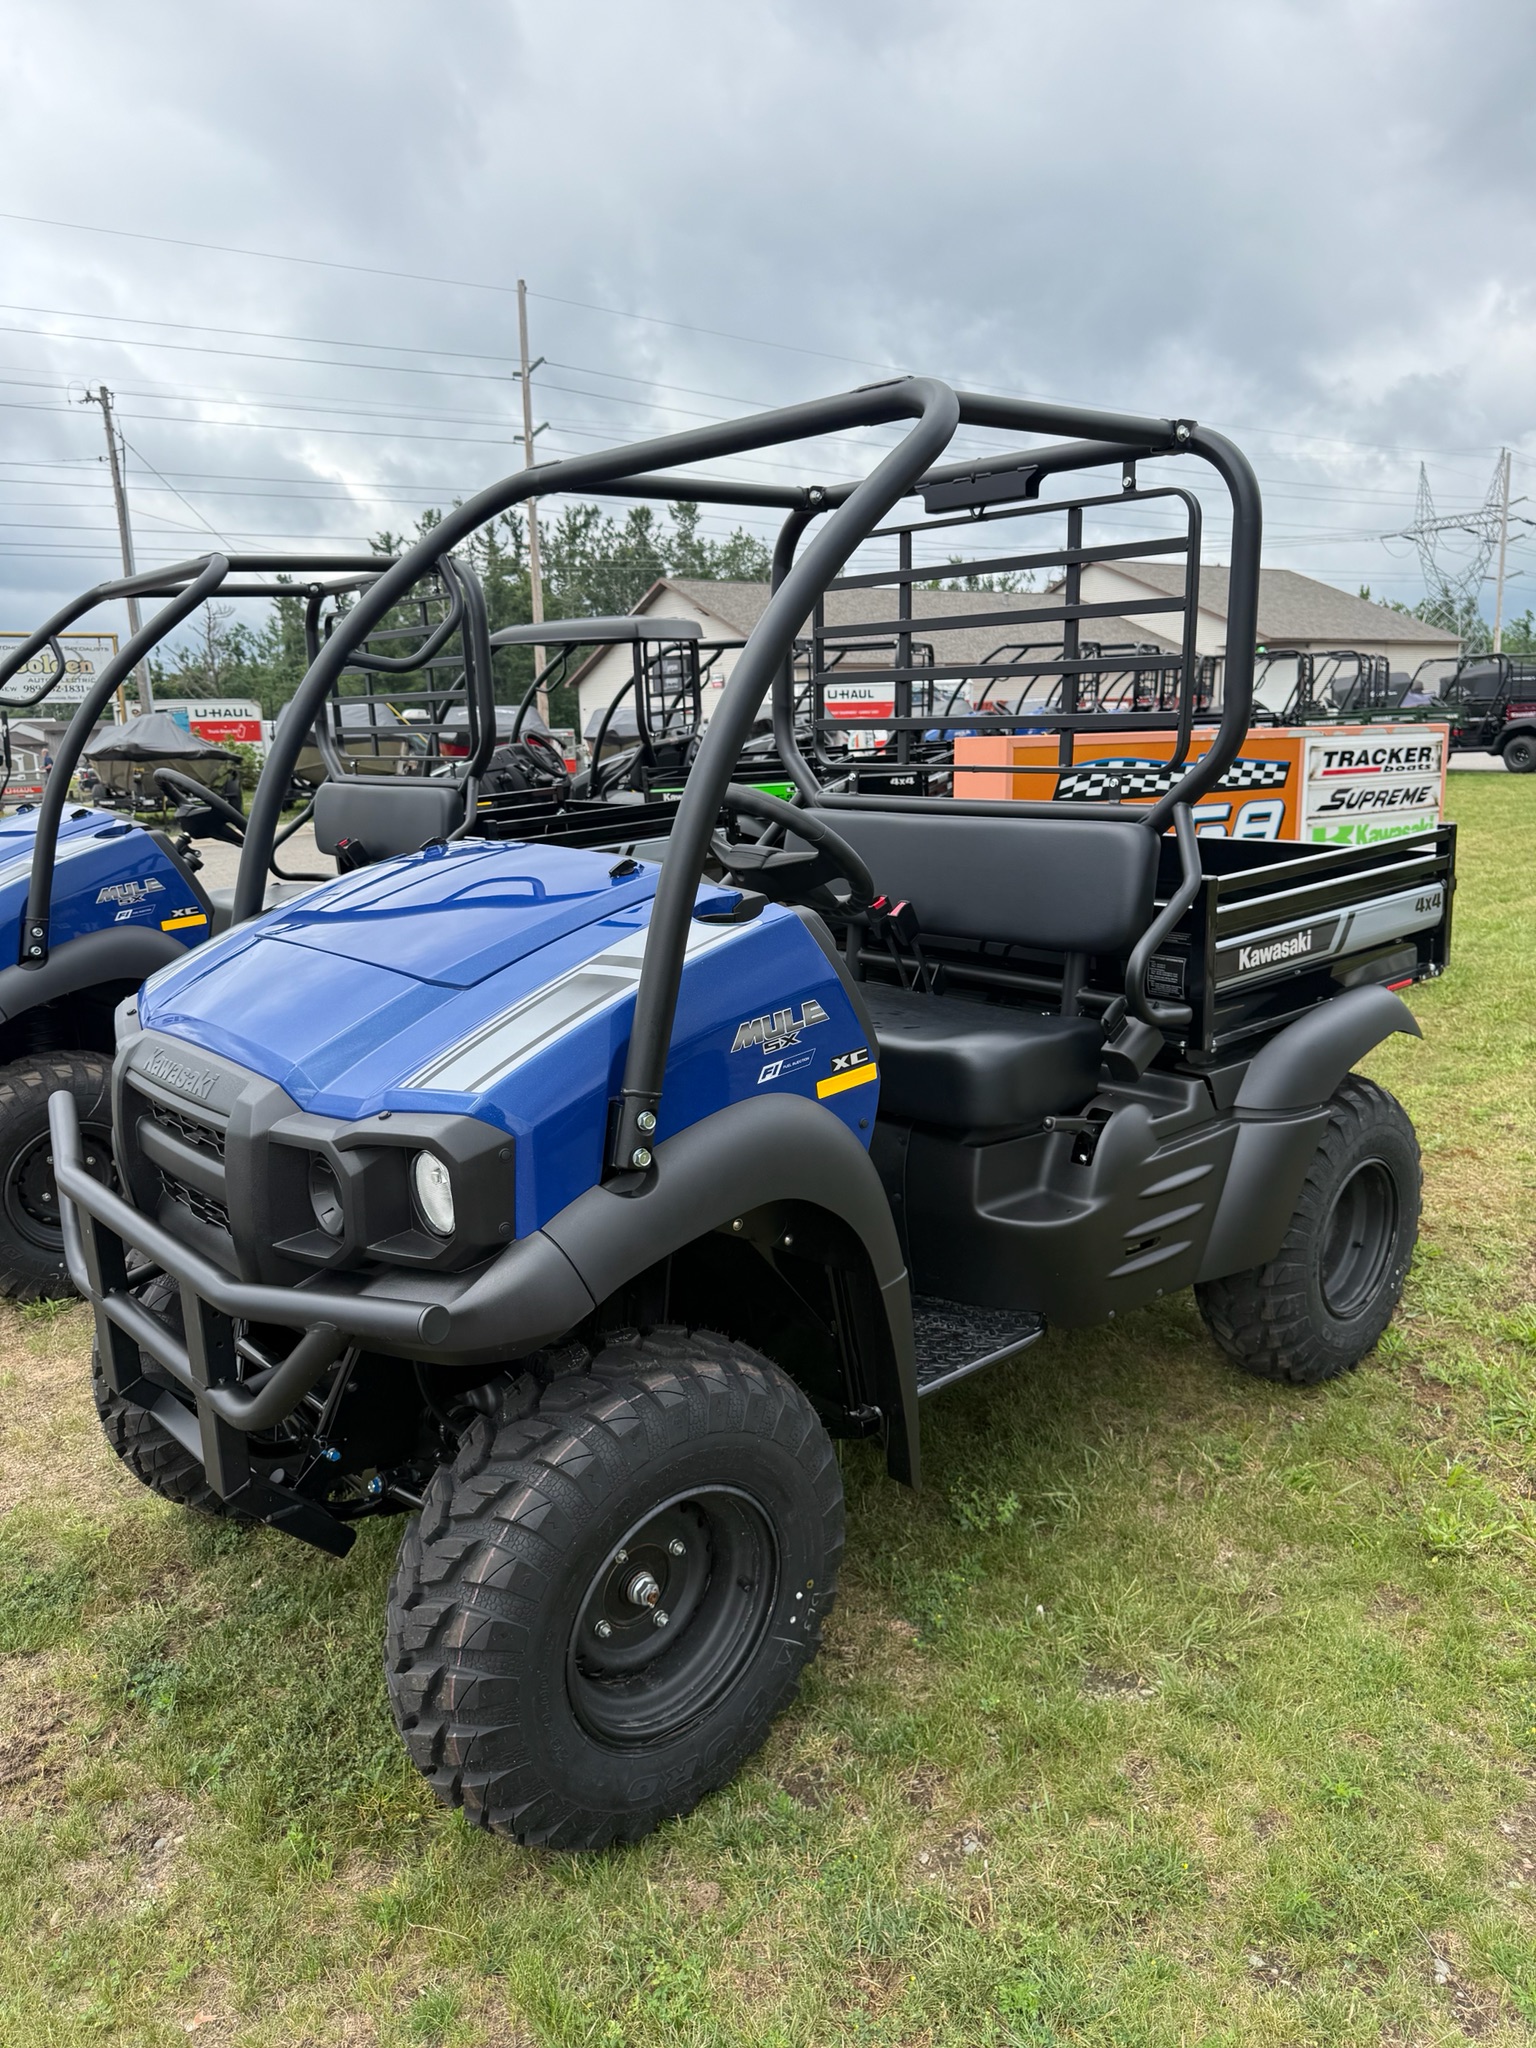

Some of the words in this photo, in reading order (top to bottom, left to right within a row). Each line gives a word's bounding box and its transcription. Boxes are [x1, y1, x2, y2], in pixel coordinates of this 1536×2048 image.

[16, 653, 95, 674] olen
[827, 689, 874, 699] U-HAUL
[195, 708, 253, 718] U-HAUL
[1323, 747, 1432, 768] TRACKER
[1383, 763, 1431, 773] boats
[890, 776, 915, 786] 4x4
[1316, 786, 1433, 812] SUPREME
[95, 877, 166, 904] MULE
[171, 906, 199, 918] XC
[1414, 892, 1442, 914] 4x4
[1238, 929, 1313, 972] Kawasaki
[730, 999, 831, 1053] MULE
[763, 1031, 802, 1055] SX
[831, 1048, 869, 1072] XC
[142, 1046, 221, 1101] Kawasaki
[626, 1686, 772, 1802] DURO
